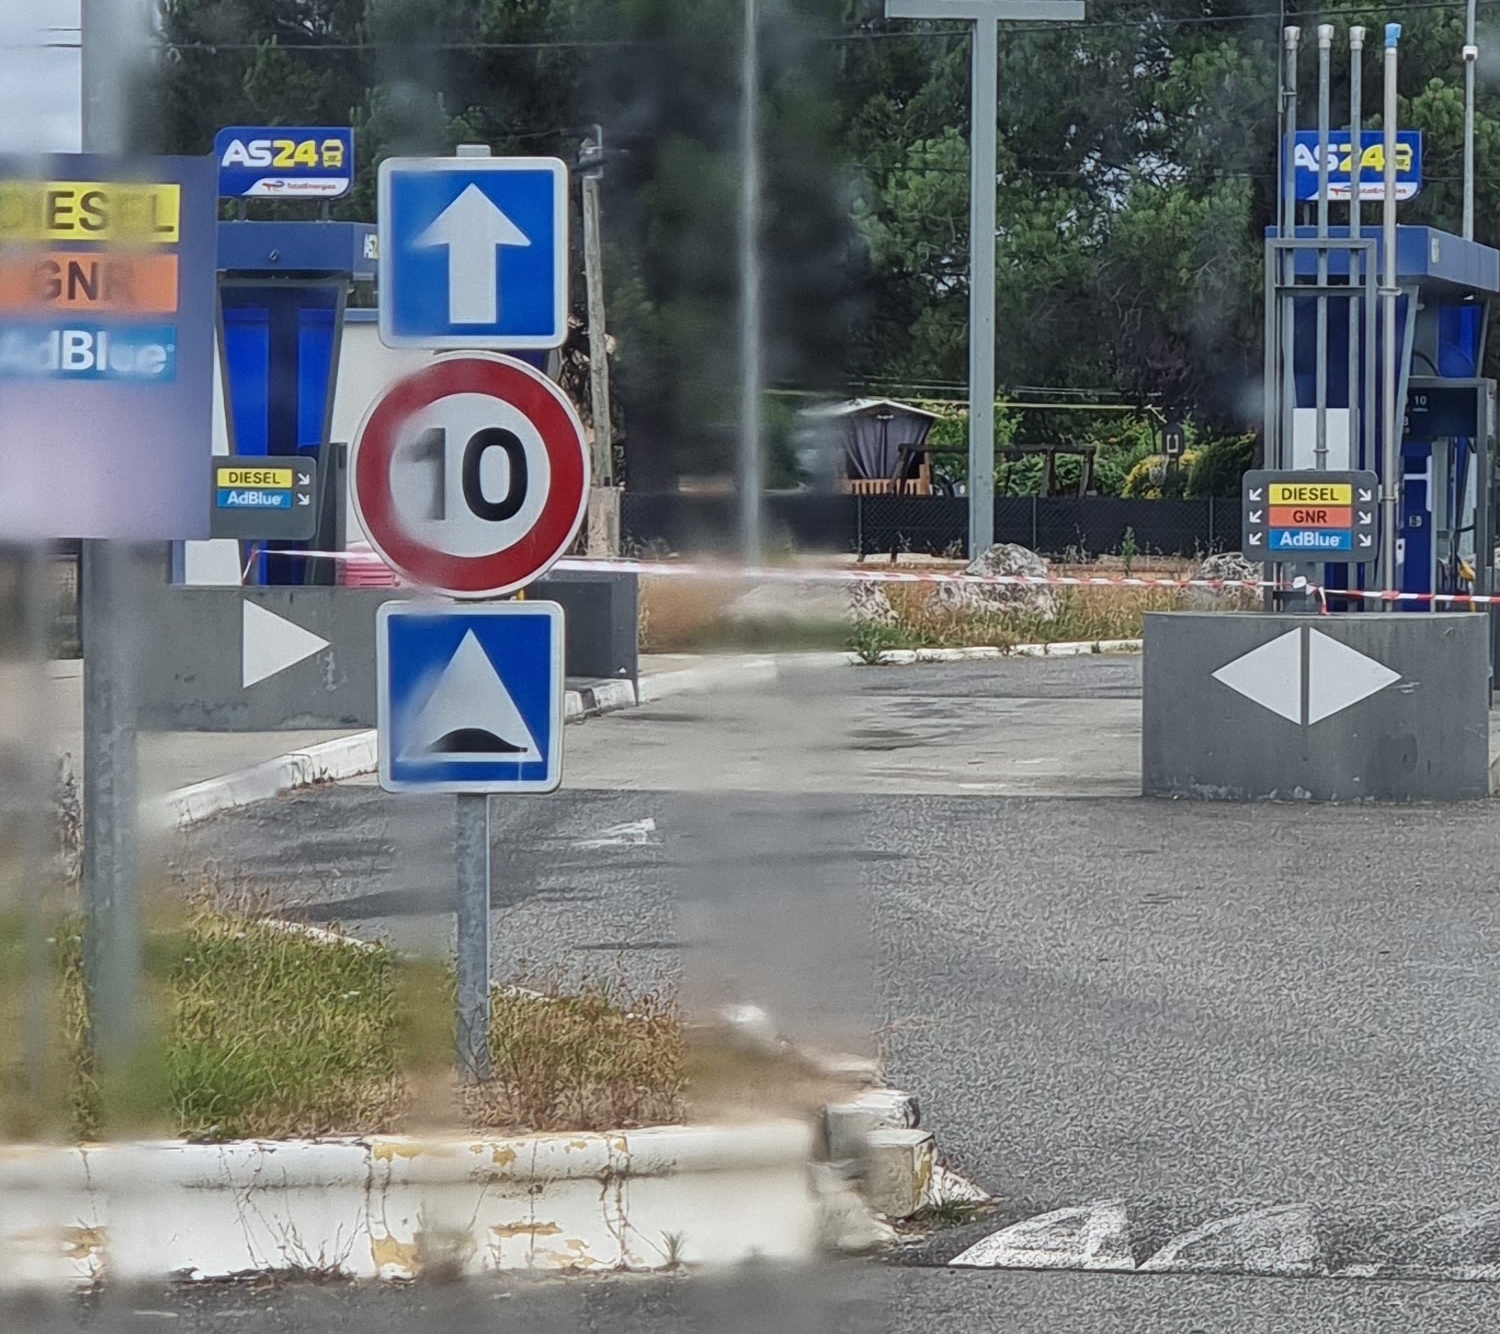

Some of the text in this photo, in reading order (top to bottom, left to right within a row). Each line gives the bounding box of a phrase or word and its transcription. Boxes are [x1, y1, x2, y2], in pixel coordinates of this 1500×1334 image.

[221, 139, 318, 167] AS24
[228, 471, 281, 484] DIESEL
[397, 427, 528, 522] 10
[1281, 487, 1339, 501] DIESEL
[1293, 510, 1327, 524] GNR
